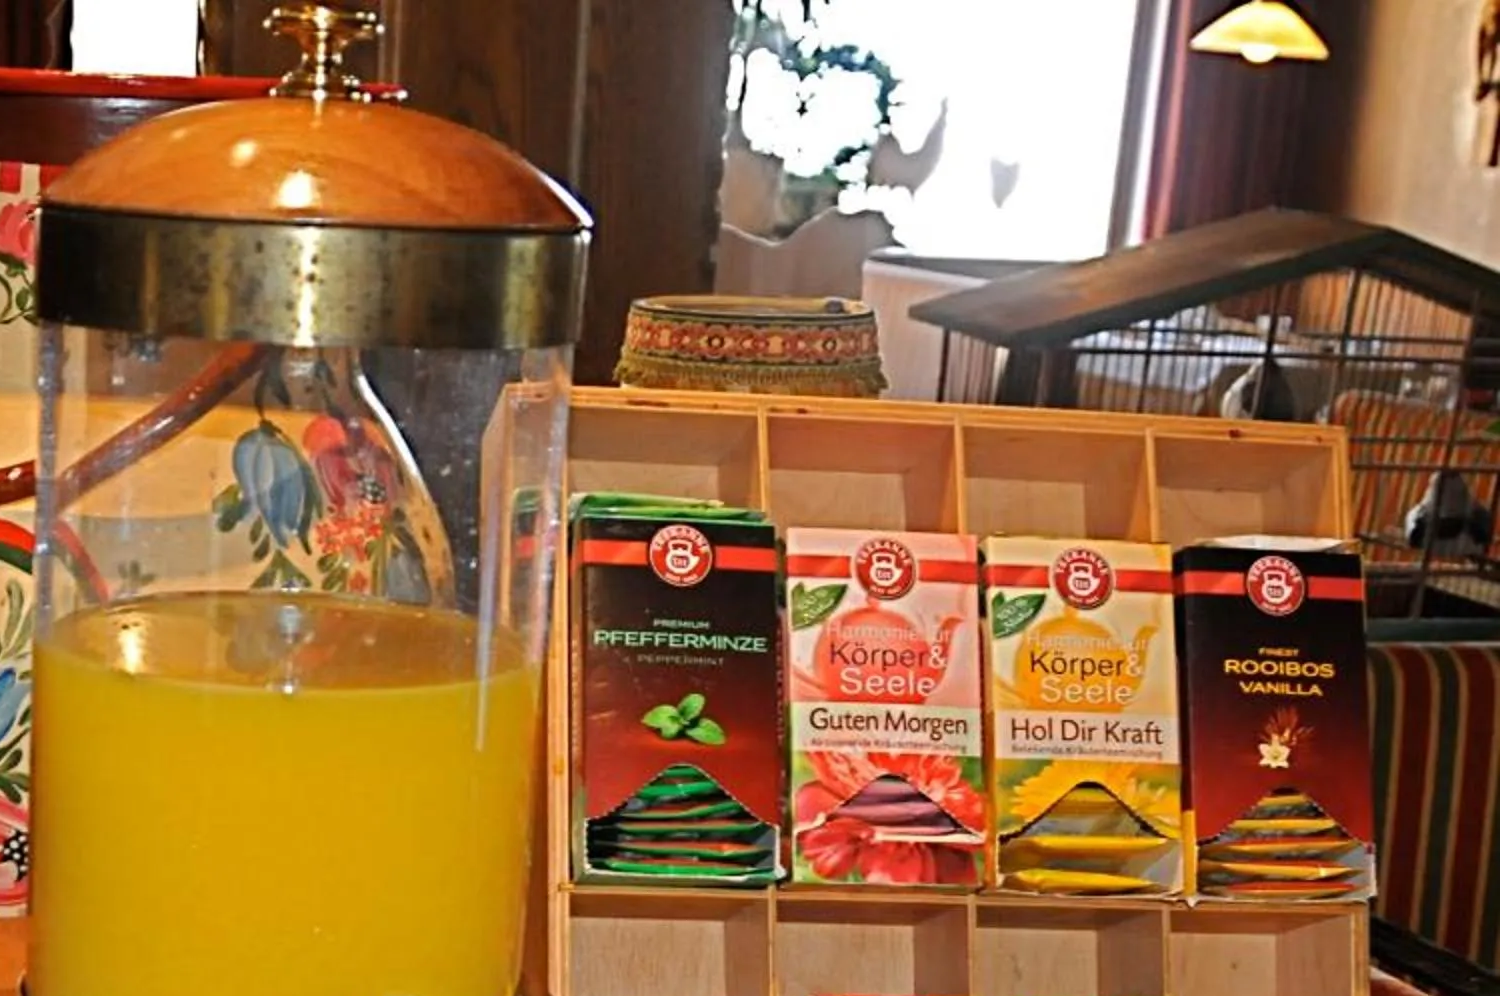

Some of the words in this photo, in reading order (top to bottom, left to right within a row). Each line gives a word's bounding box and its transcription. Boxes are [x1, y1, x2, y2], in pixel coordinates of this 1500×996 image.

[653, 619, 710, 629] PREMIUM
[593, 629, 768, 653] PFEFFERMINZE
[829, 641, 927, 672] Körper
[928, 643, 947, 669] &
[1030, 650, 1125, 680] Körper
[1224, 659, 1335, 678] ROOIBOS
[840, 668, 936, 697] Seele
[1041, 678, 1133, 704] Seele
[1239, 680, 1323, 696] VANILLA
[809, 707, 879, 731] Guten
[884, 711, 968, 741] Morgen
[1011, 717, 1053, 741] Hol
[1061, 719, 1097, 742] Dir
[1104, 721, 1164, 745] Kraft
